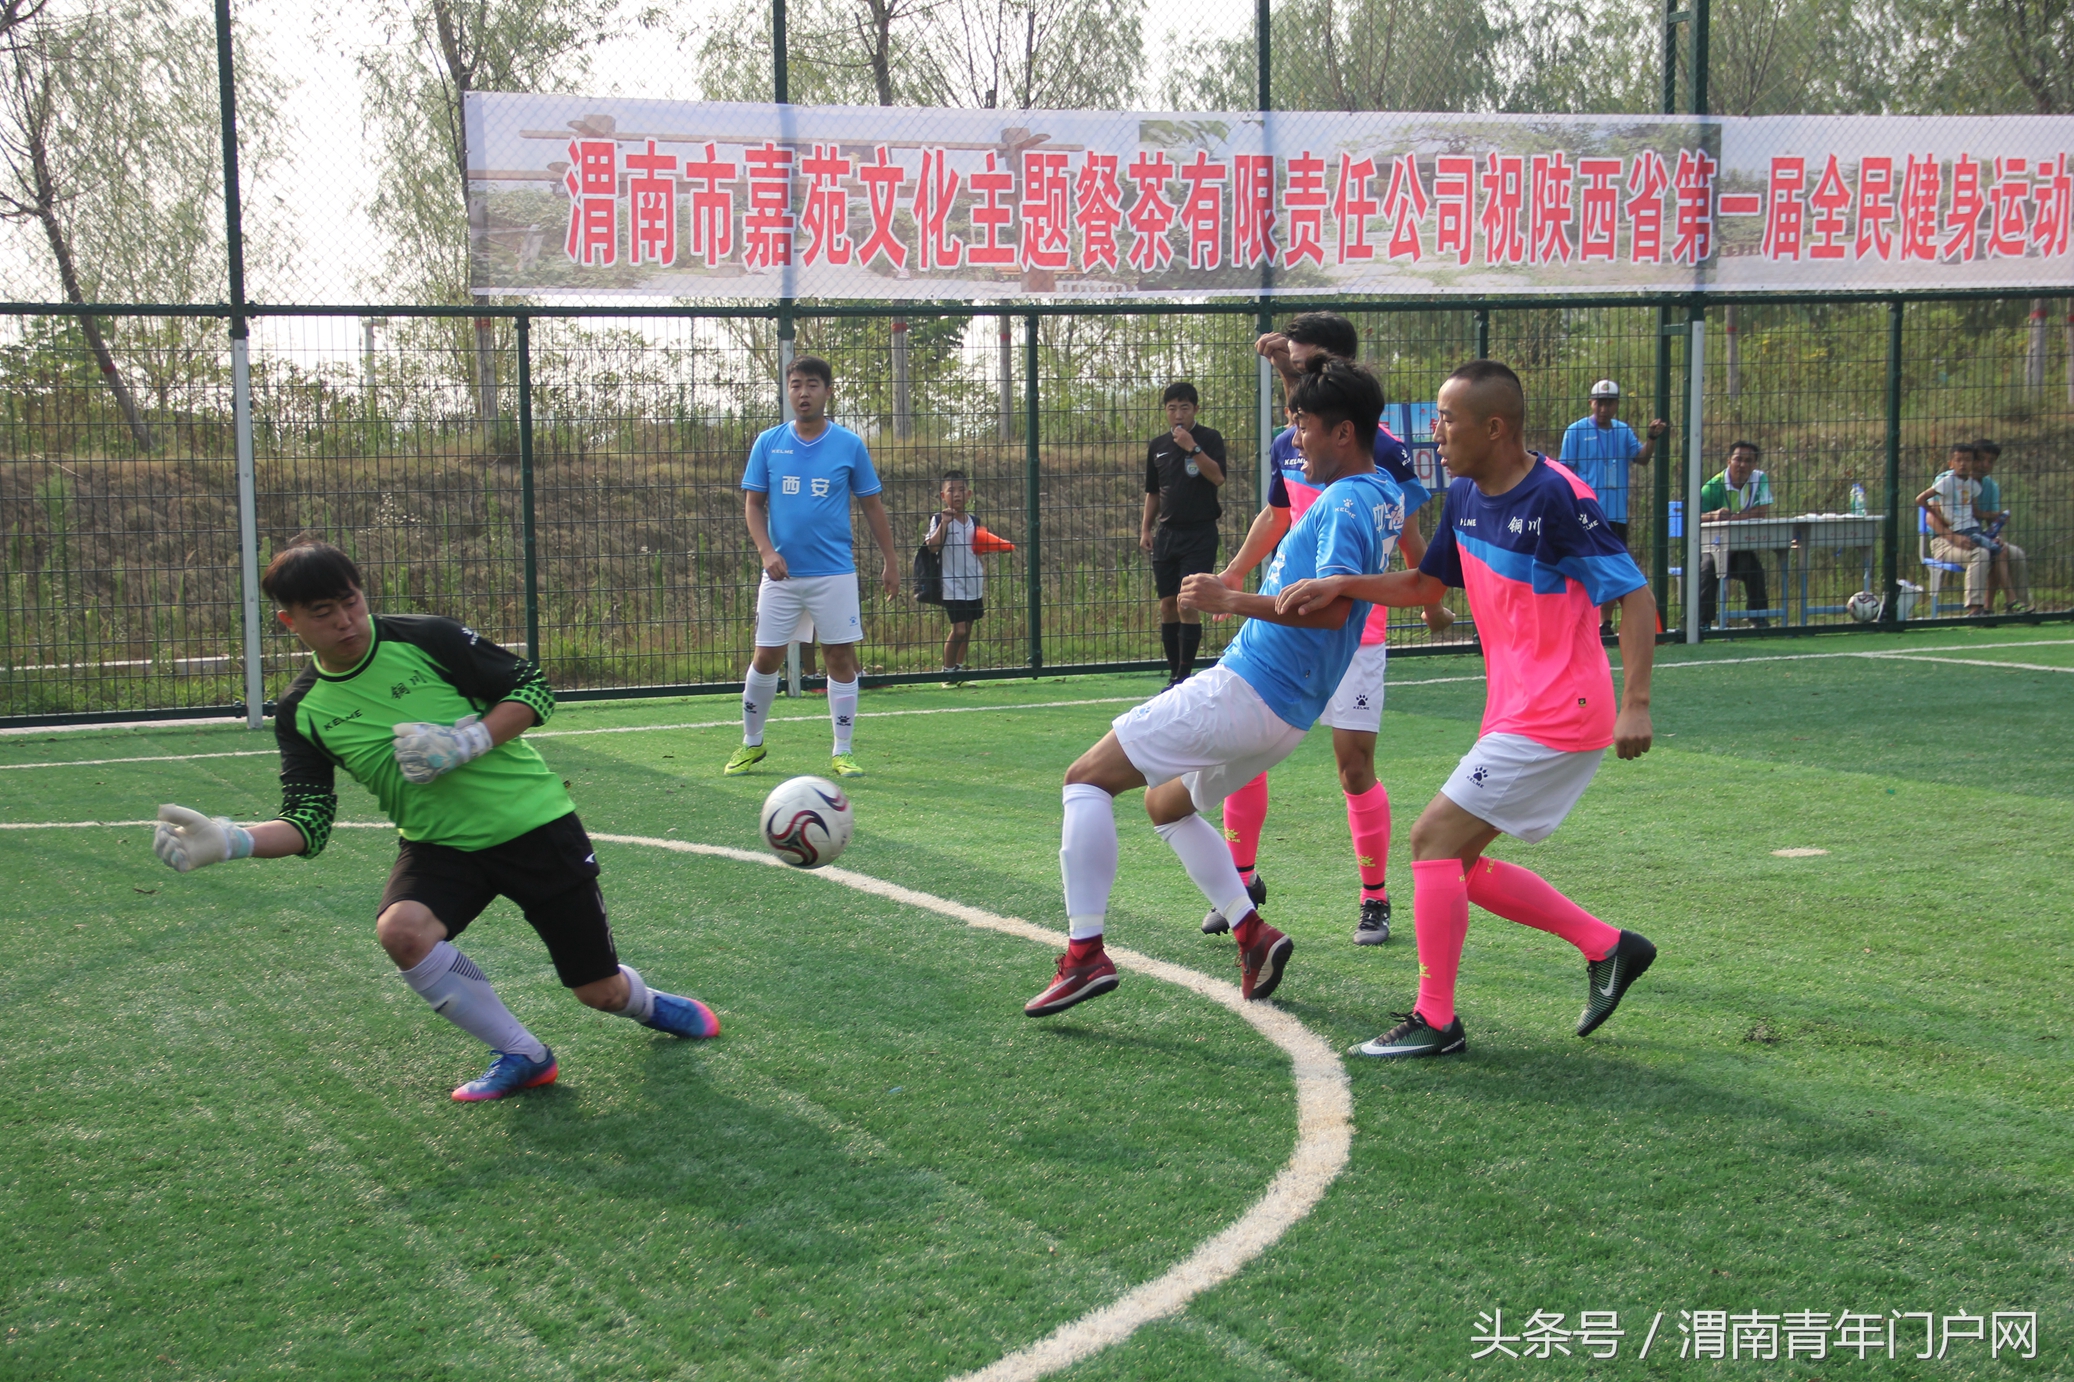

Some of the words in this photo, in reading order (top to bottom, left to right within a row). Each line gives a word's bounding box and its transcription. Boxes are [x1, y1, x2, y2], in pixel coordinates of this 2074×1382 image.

[563, 136, 2073, 274] 渭南市嘉苑文化主题餐茶有限责任公司祝陕西省第一届全民健身运动
[1284, 457, 1306, 466] KELM
[782, 475, 830, 498] 西安
